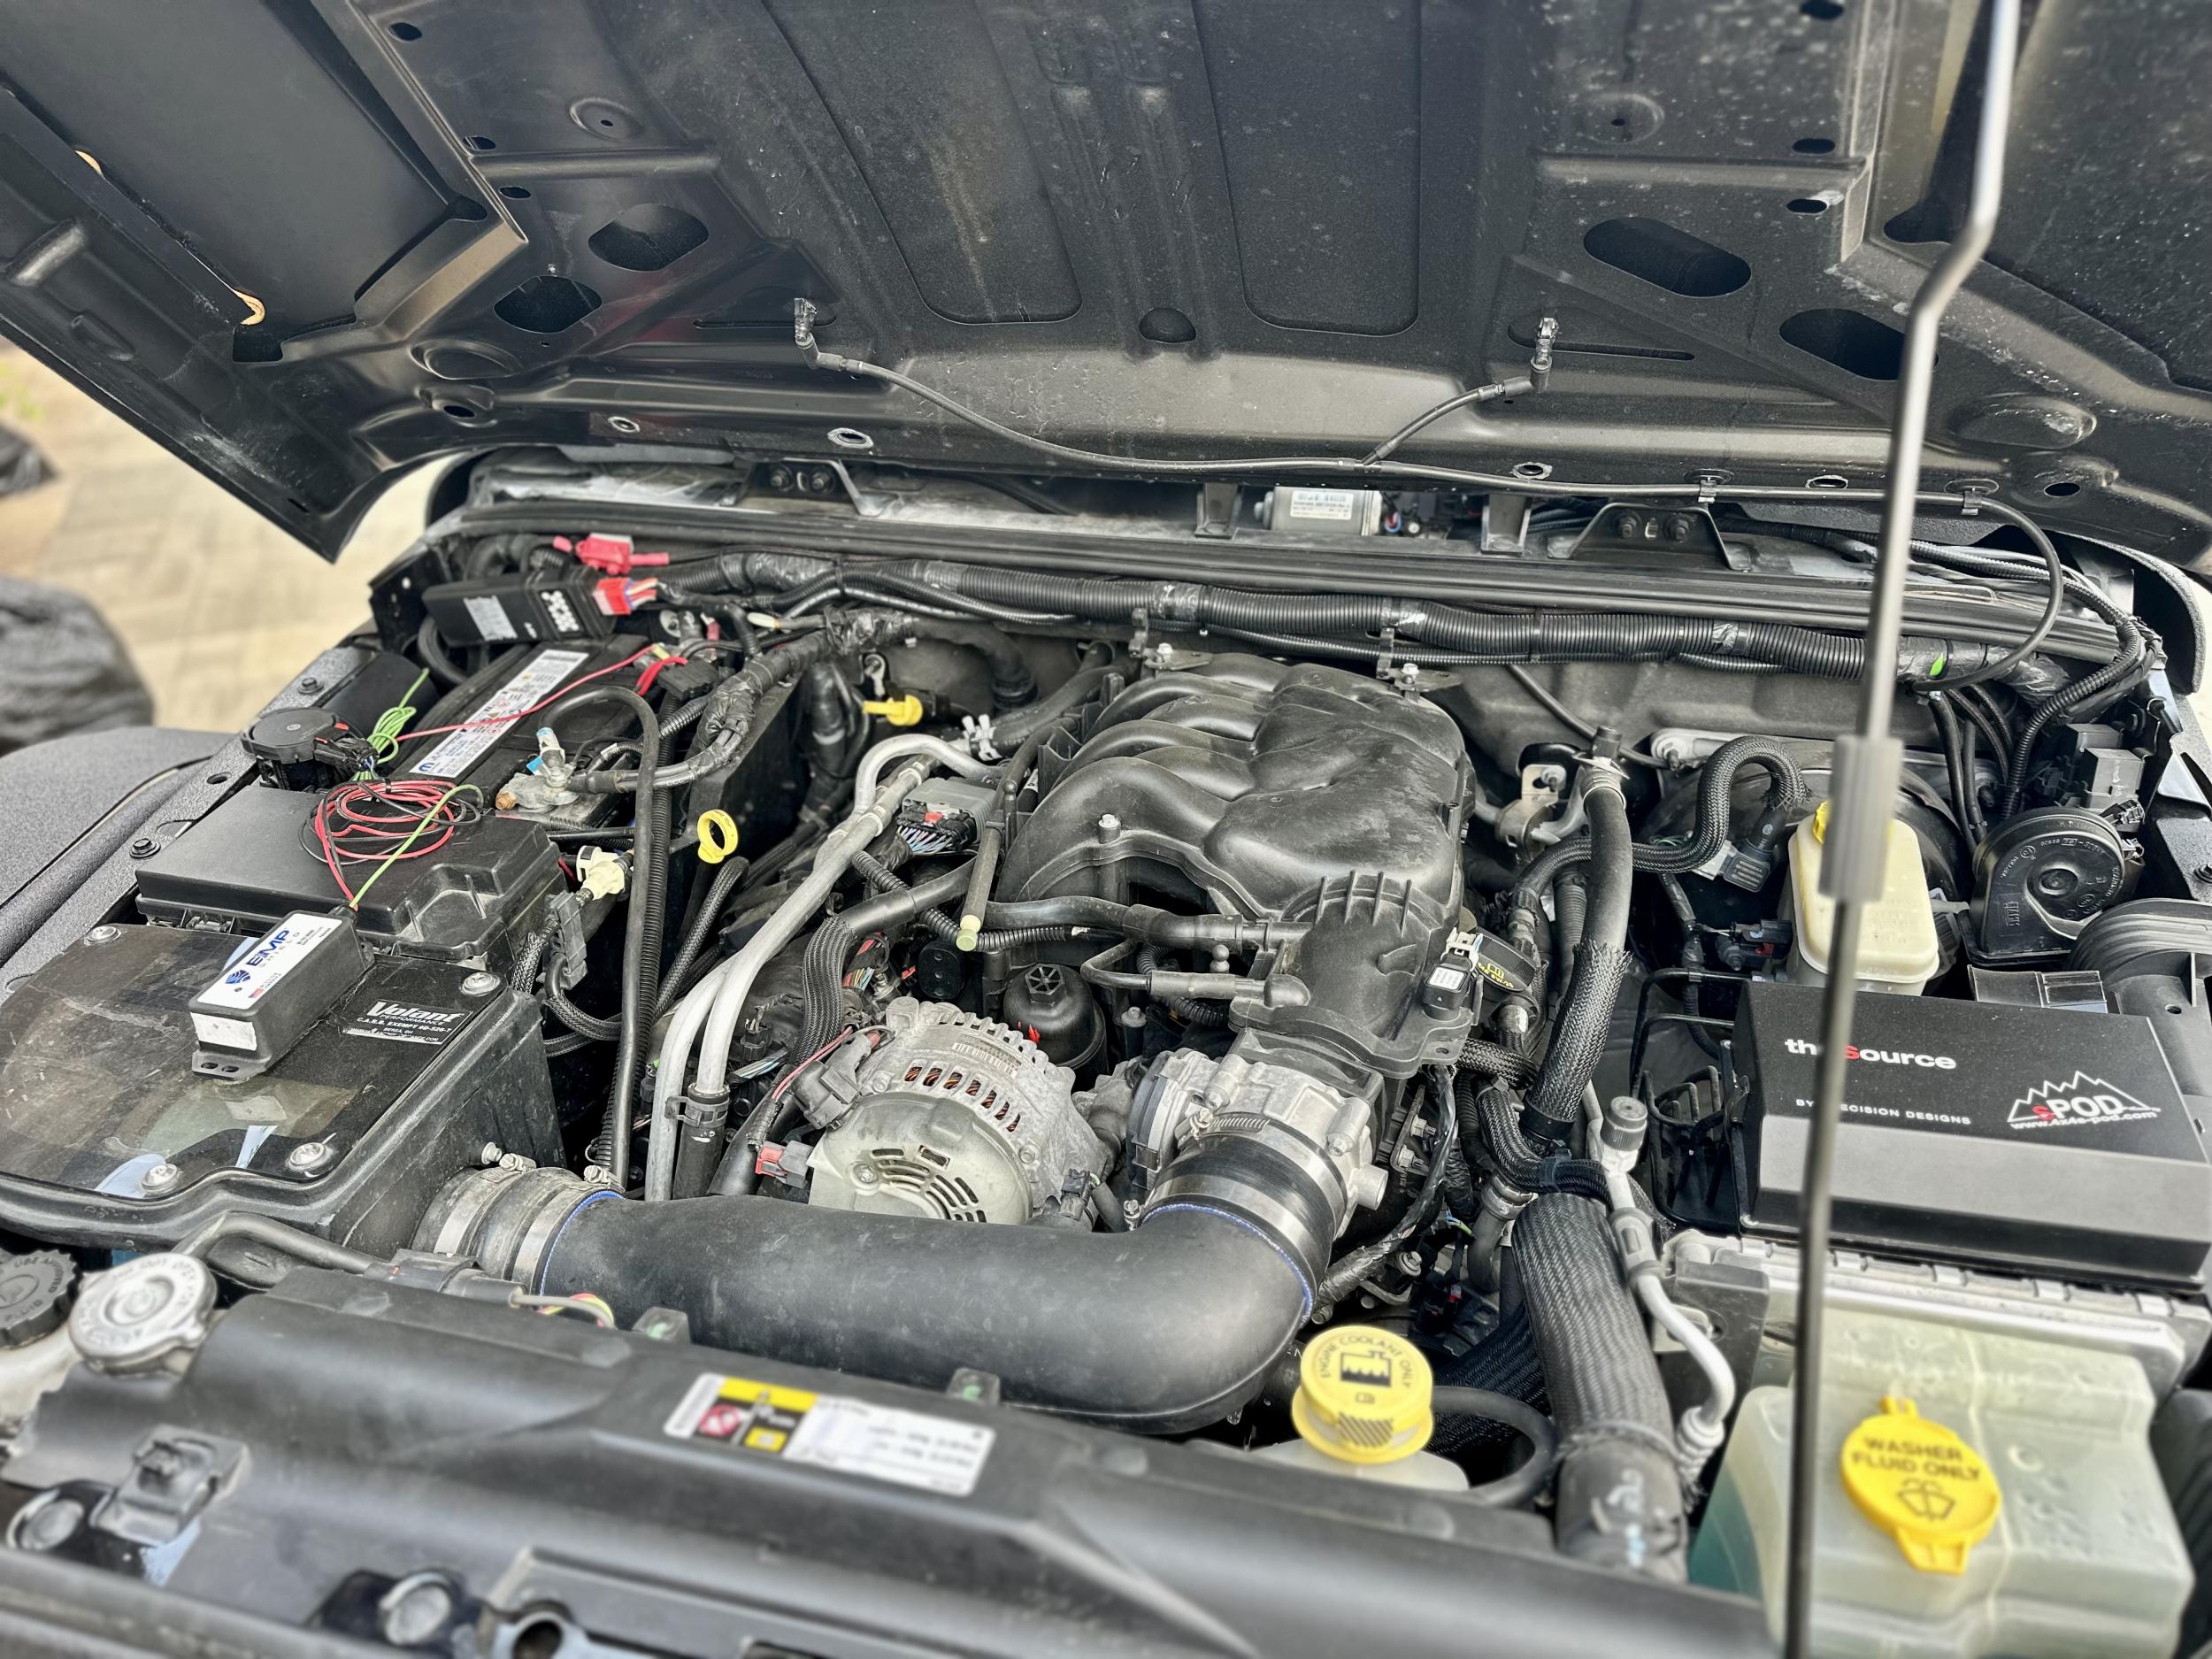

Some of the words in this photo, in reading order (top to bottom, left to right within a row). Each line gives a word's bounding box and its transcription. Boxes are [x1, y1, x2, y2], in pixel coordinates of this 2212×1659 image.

[246, 929, 290, 966] EMP
[366, 1001, 465, 1022] Volant
[379, 1014, 445, 1026] PERFORMANCE
[1839, 1103, 1900, 1118] ECISION
[1905, 1110, 1971, 1125] DESIGNS
[1319, 1343, 1338, 1378] ENGINE
[1339, 1334, 1403, 1357] COOLANT
[1399, 1359, 1414, 1388] ONLY
[1863, 1437, 1962, 1461] WASHER
[1851, 1451, 1917, 1472] FLUID
[1923, 1461, 1979, 1482] ONLY
